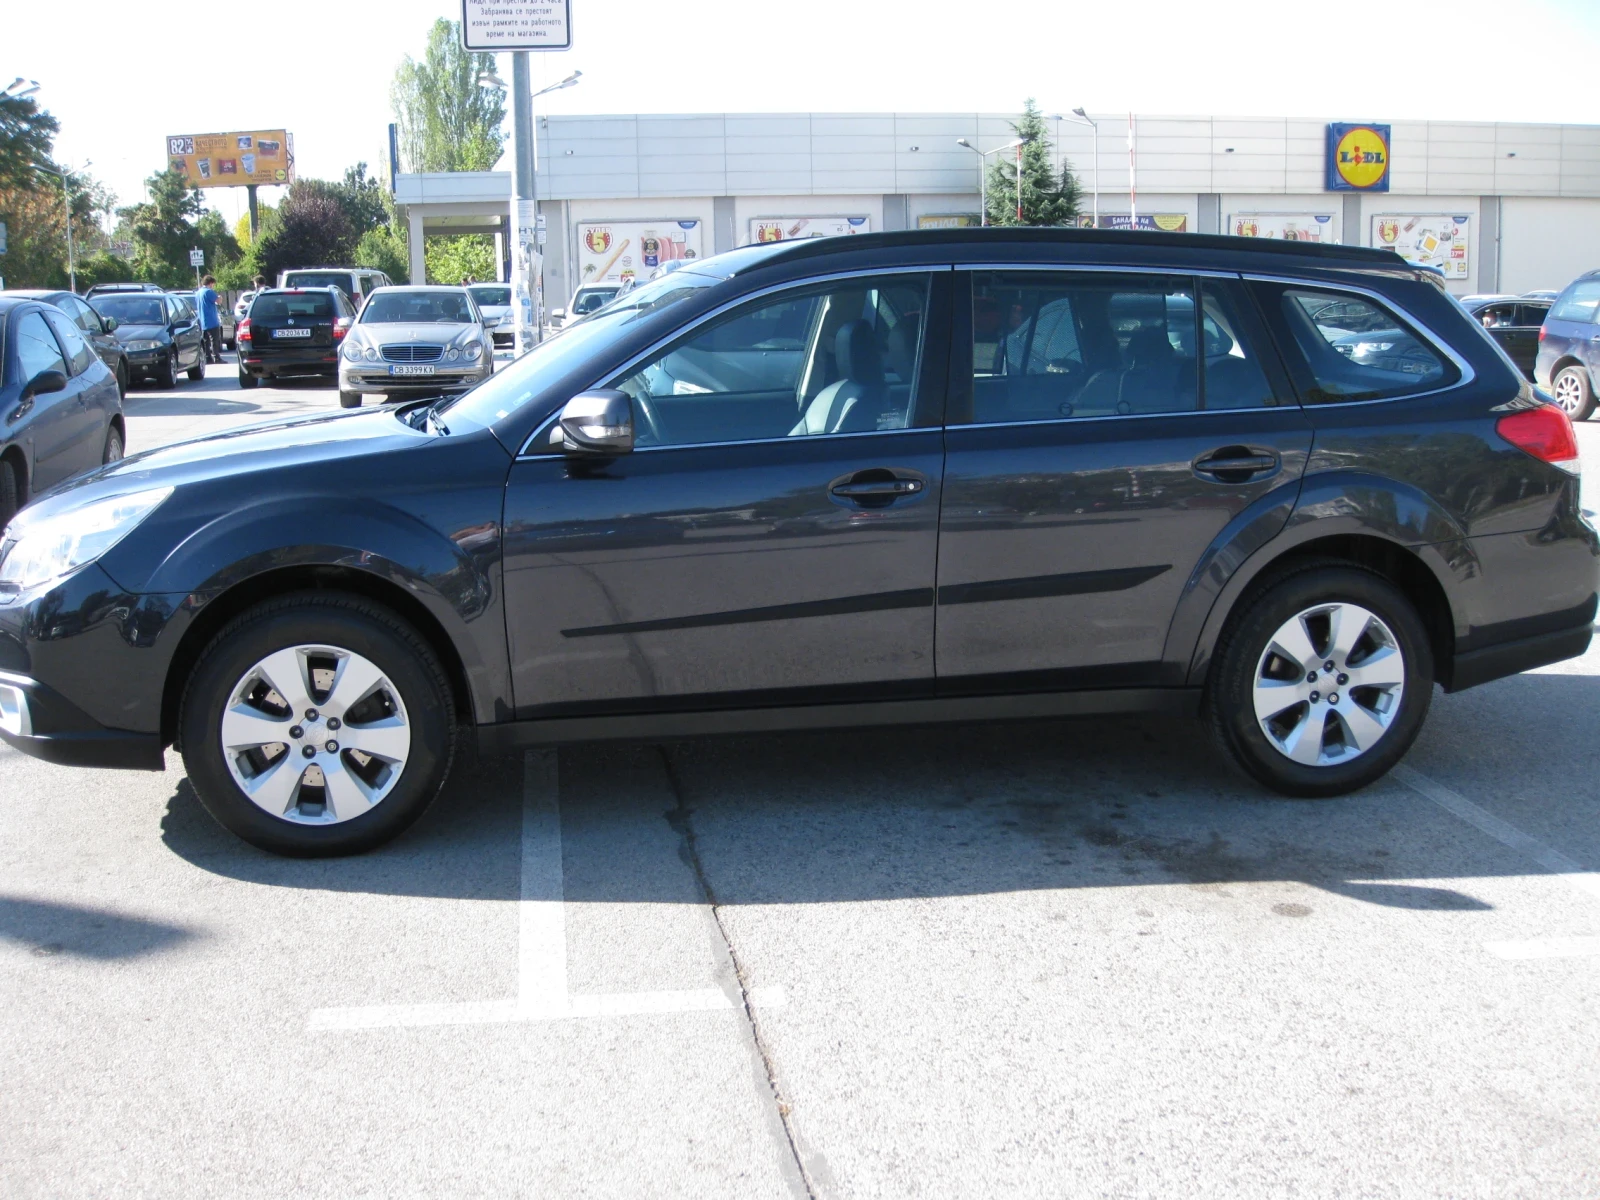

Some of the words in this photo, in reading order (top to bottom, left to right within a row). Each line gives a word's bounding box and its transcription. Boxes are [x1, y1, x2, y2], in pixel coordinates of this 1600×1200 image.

[480, 8, 513, 16] Забранява
[395, 366, 404, 374] CB
[405, 366, 422, 374] 3399
[424, 366, 433, 374] KX
